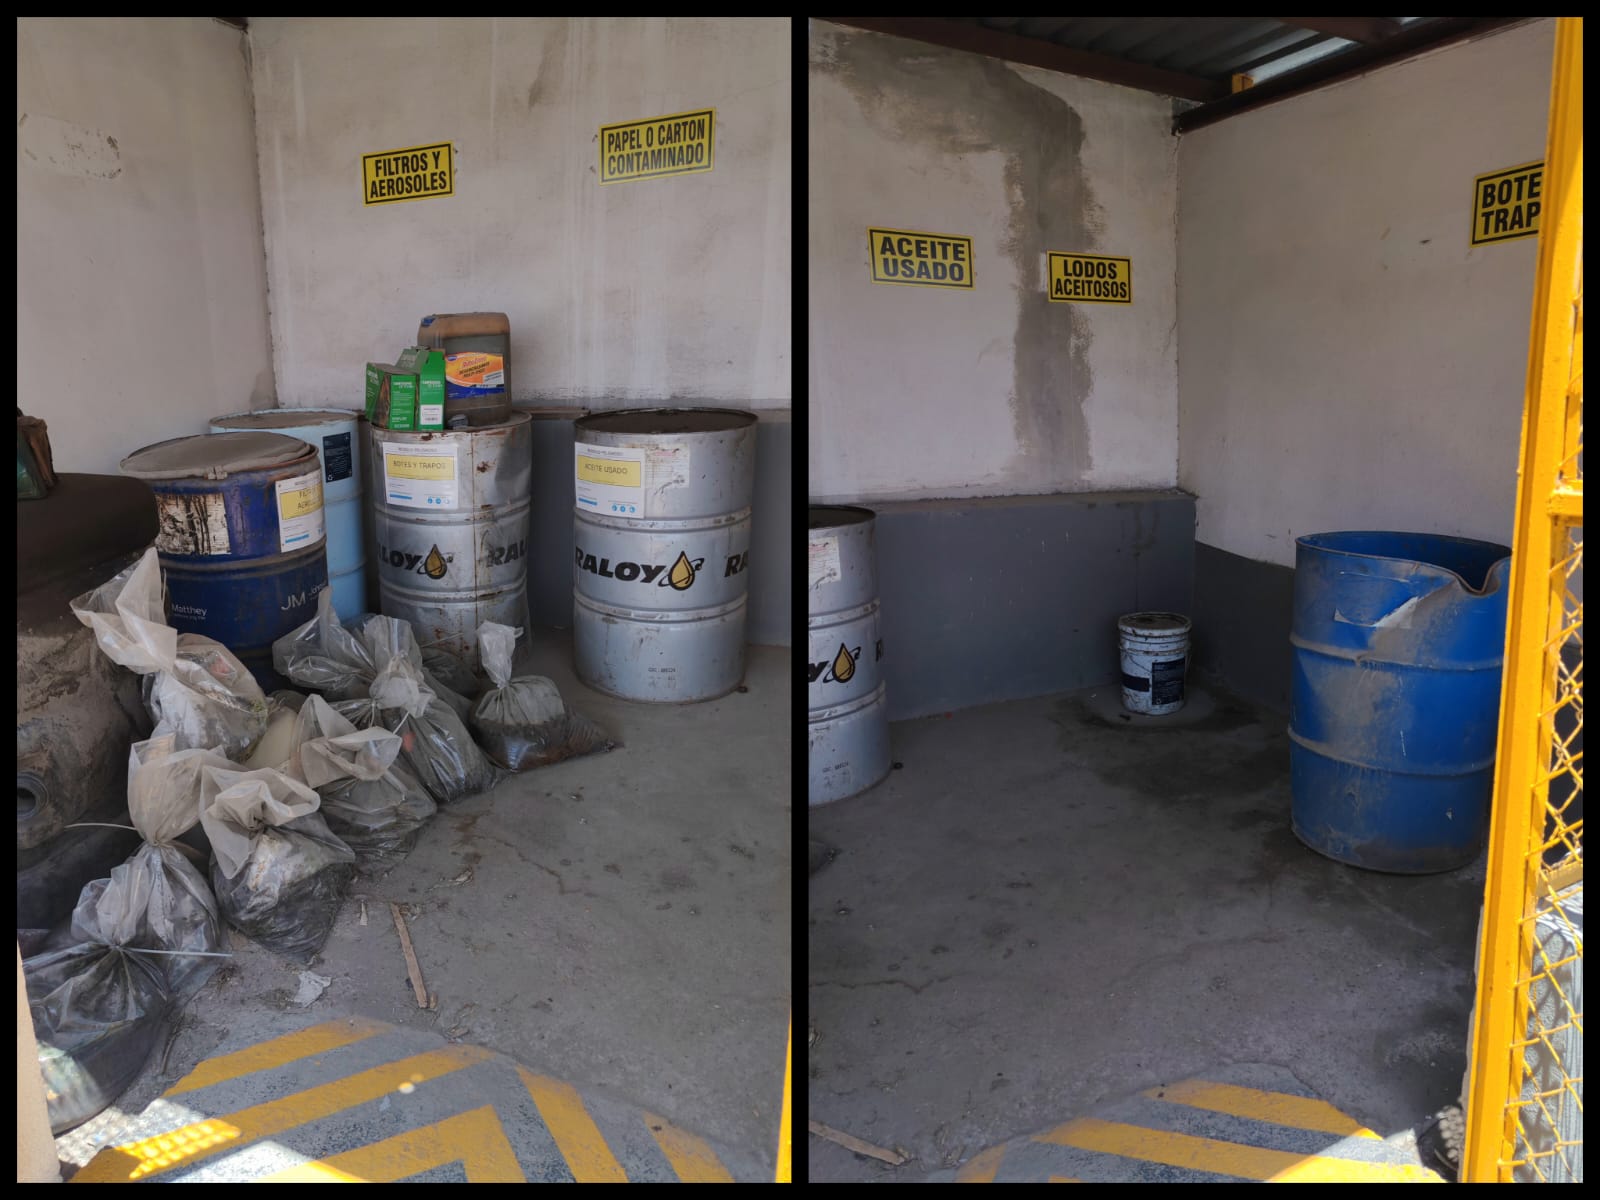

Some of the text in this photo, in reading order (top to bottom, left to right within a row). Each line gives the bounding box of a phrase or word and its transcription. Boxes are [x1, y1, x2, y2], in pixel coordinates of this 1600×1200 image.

[608, 118, 705, 153] PAPEL O CARTON
[375, 150, 440, 178] FILTROS Y
[607, 142, 705, 176] CONTAMINADO
[370, 170, 447, 198] AEROSOLES
[880, 236, 966, 262] ACEITE
[883, 258, 964, 282] USADO
[1063, 259, 1118, 279] LODOS
[1054, 279, 1128, 298] ACEITOSOS
[603, 466, 628, 475] USADO
[575, 546, 666, 583] RALOY
[280, 591, 306, 611] JM
